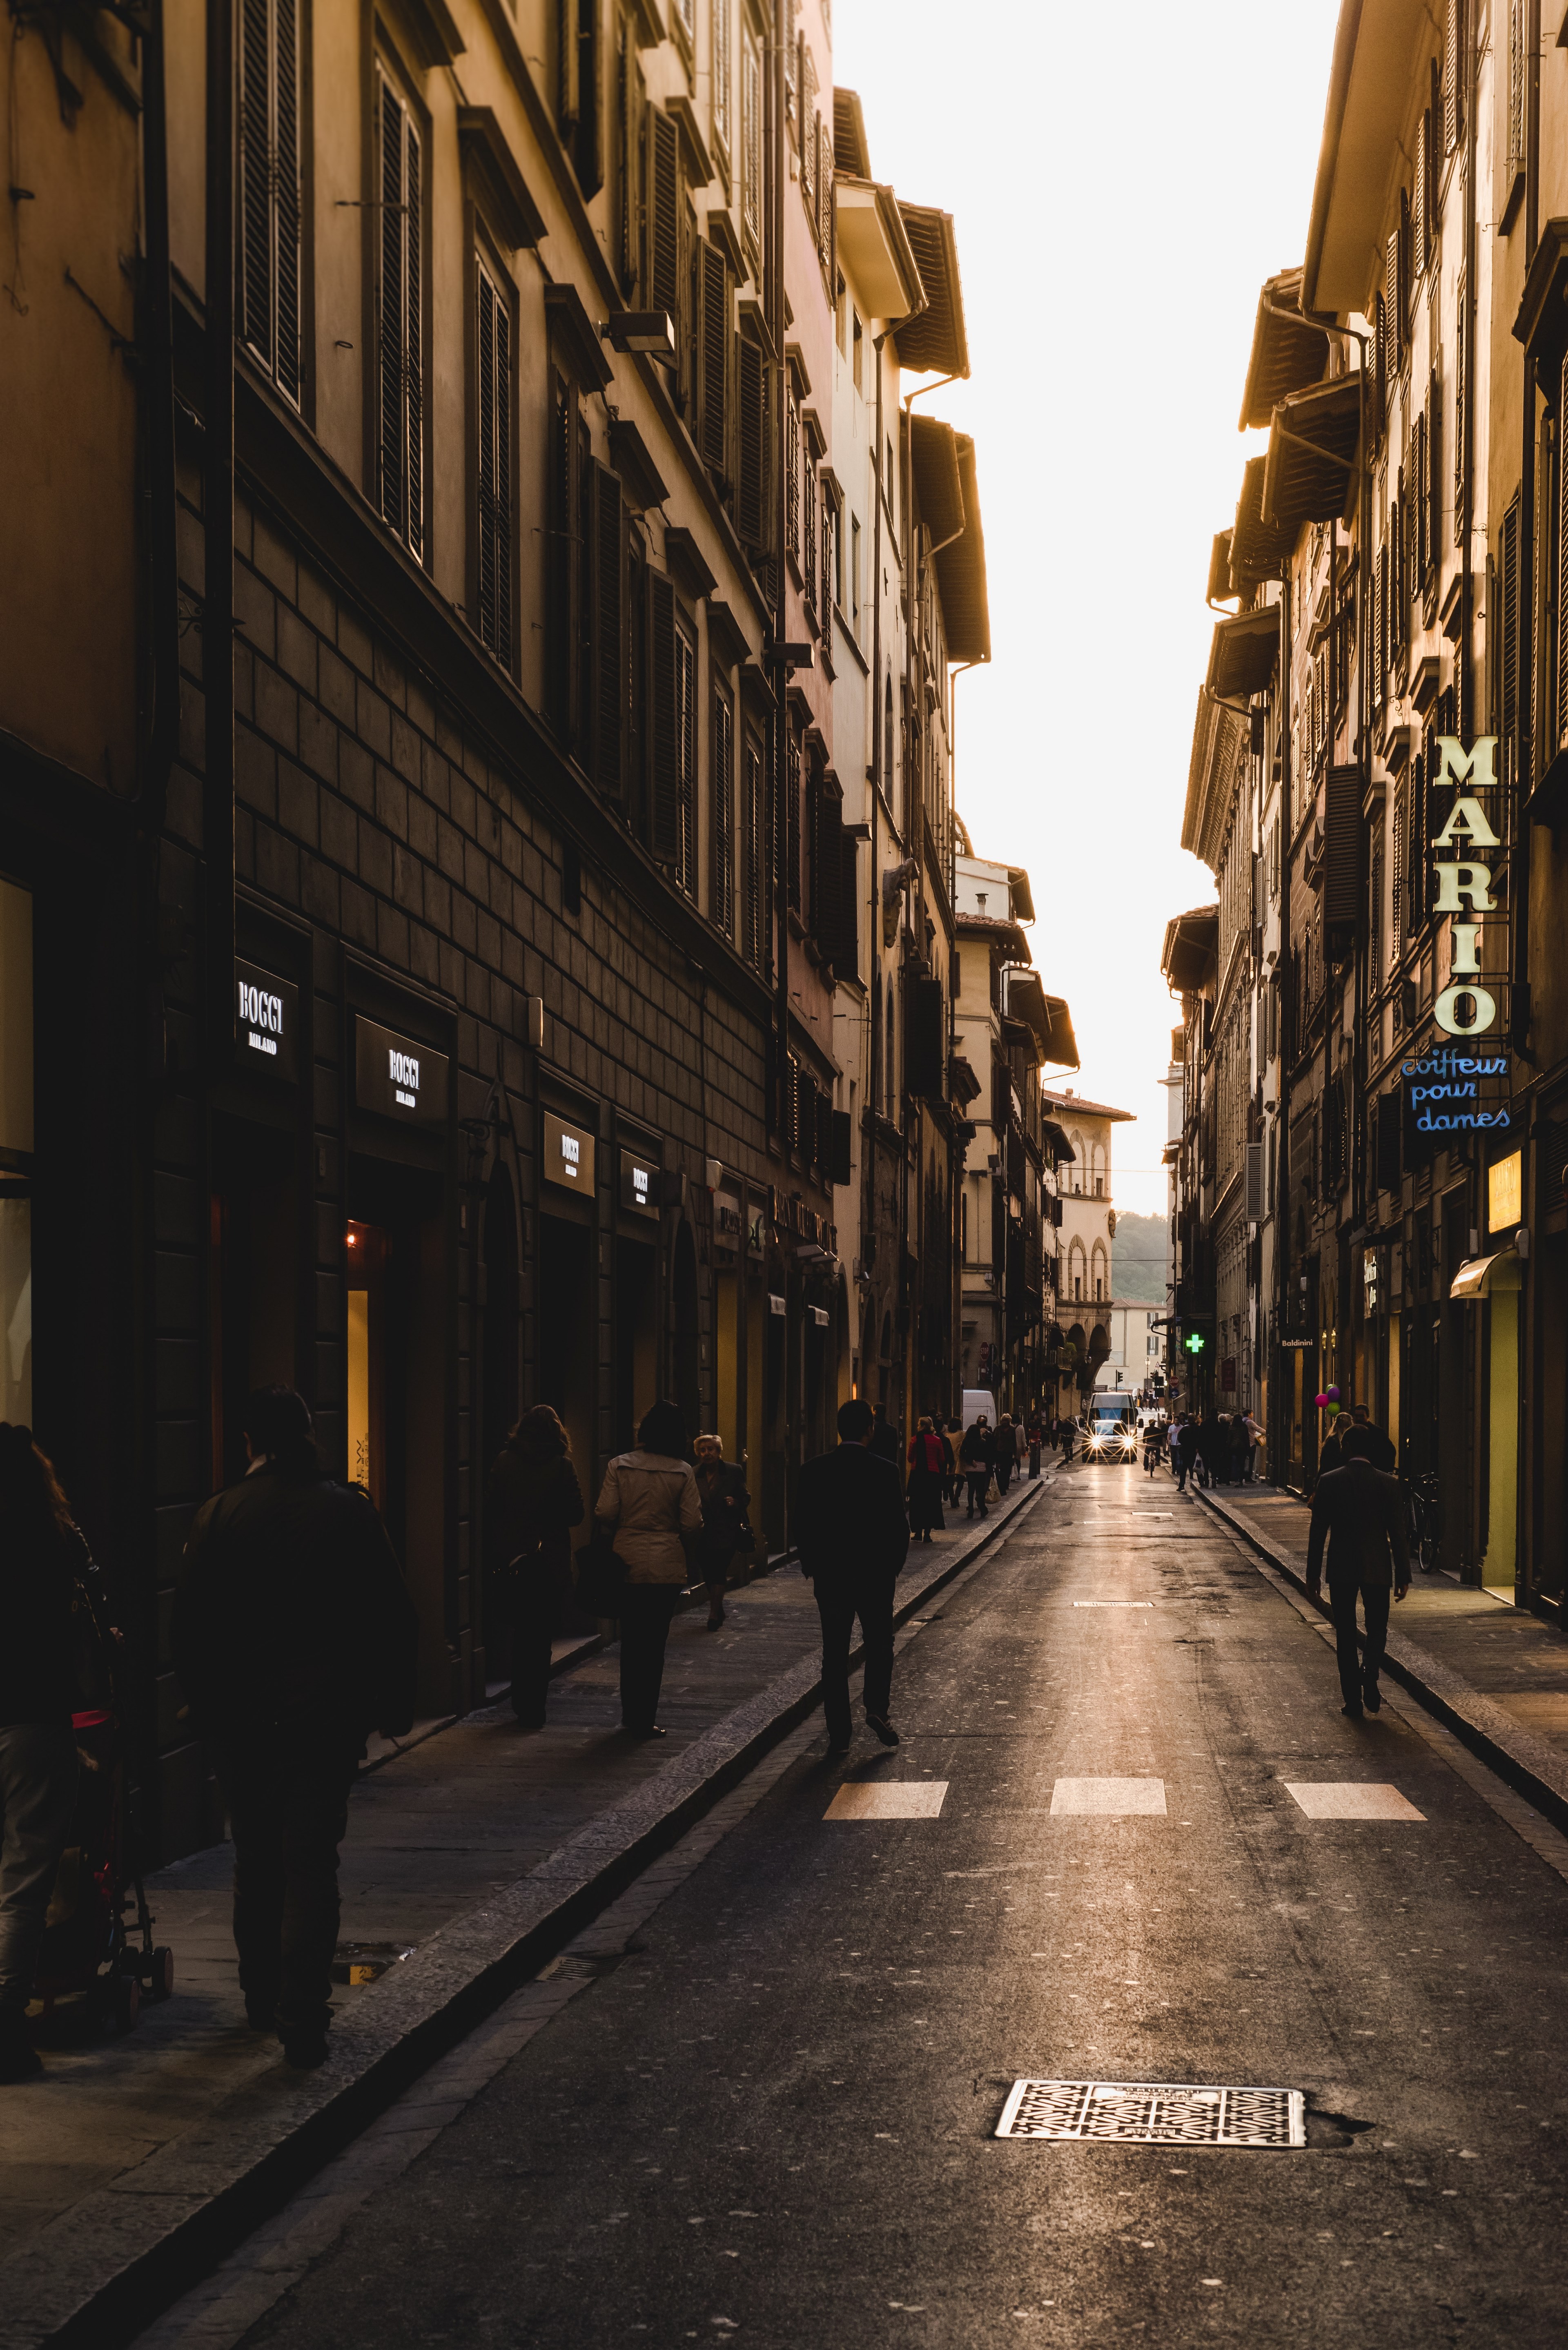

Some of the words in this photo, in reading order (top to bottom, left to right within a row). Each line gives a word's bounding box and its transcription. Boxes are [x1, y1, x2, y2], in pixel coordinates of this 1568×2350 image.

[1432, 736, 1501, 1036] MARIO
[238, 981, 284, 1034] BOGGI
[248, 1032, 277, 1055] MILANO
[389, 1049, 420, 1090] BOGGI
[1401, 1048, 1508, 1079] coiffeur
[1411, 1082, 1477, 1110] pour
[1417, 1107, 1510, 1131] dames
[562, 1134, 579, 1163] BOGGI
